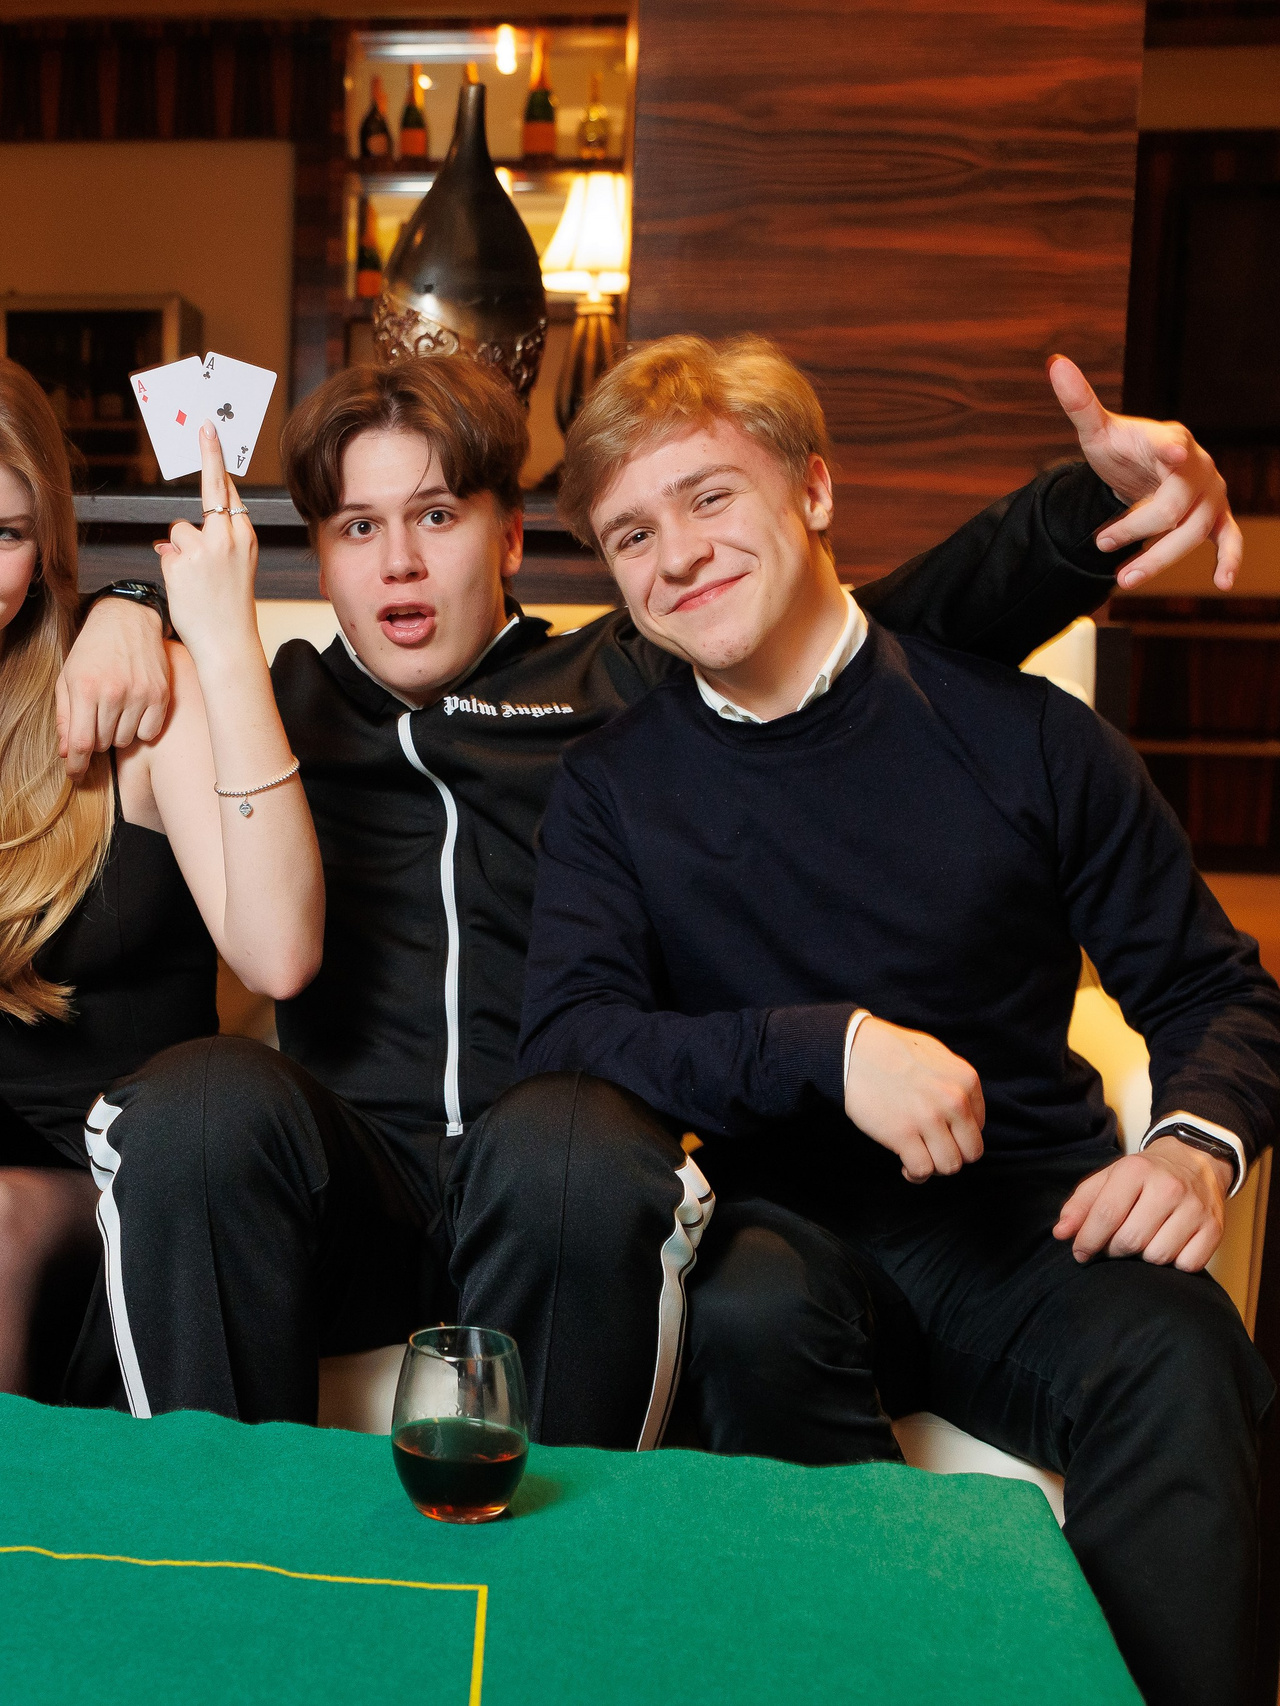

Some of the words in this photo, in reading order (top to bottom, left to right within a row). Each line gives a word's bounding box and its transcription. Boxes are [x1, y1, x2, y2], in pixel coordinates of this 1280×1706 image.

[206, 356, 215, 370] A
[137, 379, 147, 393] A
[236, 455, 246, 469] A
[443, 695, 498, 716] Palm
[501, 704, 573, 718] Angels
